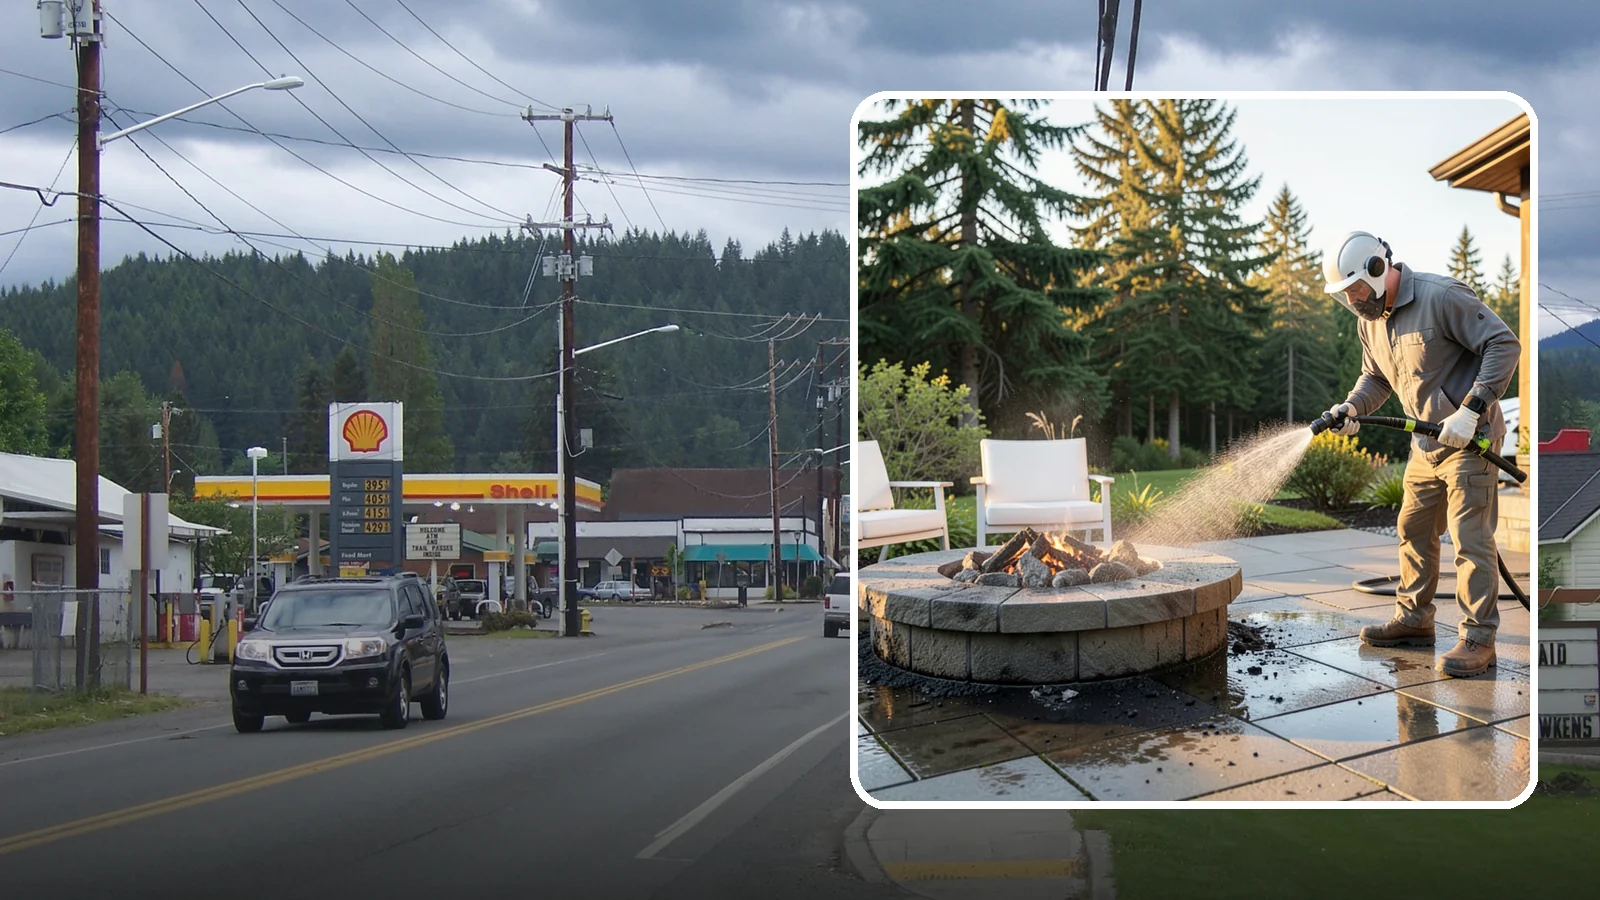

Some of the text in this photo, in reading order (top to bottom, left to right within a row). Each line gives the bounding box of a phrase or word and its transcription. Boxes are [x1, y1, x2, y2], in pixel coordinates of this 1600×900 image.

[365, 479, 383, 490] 395
[490, 484, 547, 499] Shell
[365, 494, 383, 504] 405
[365, 508, 383, 518] 415
[365, 522, 383, 532] 429
